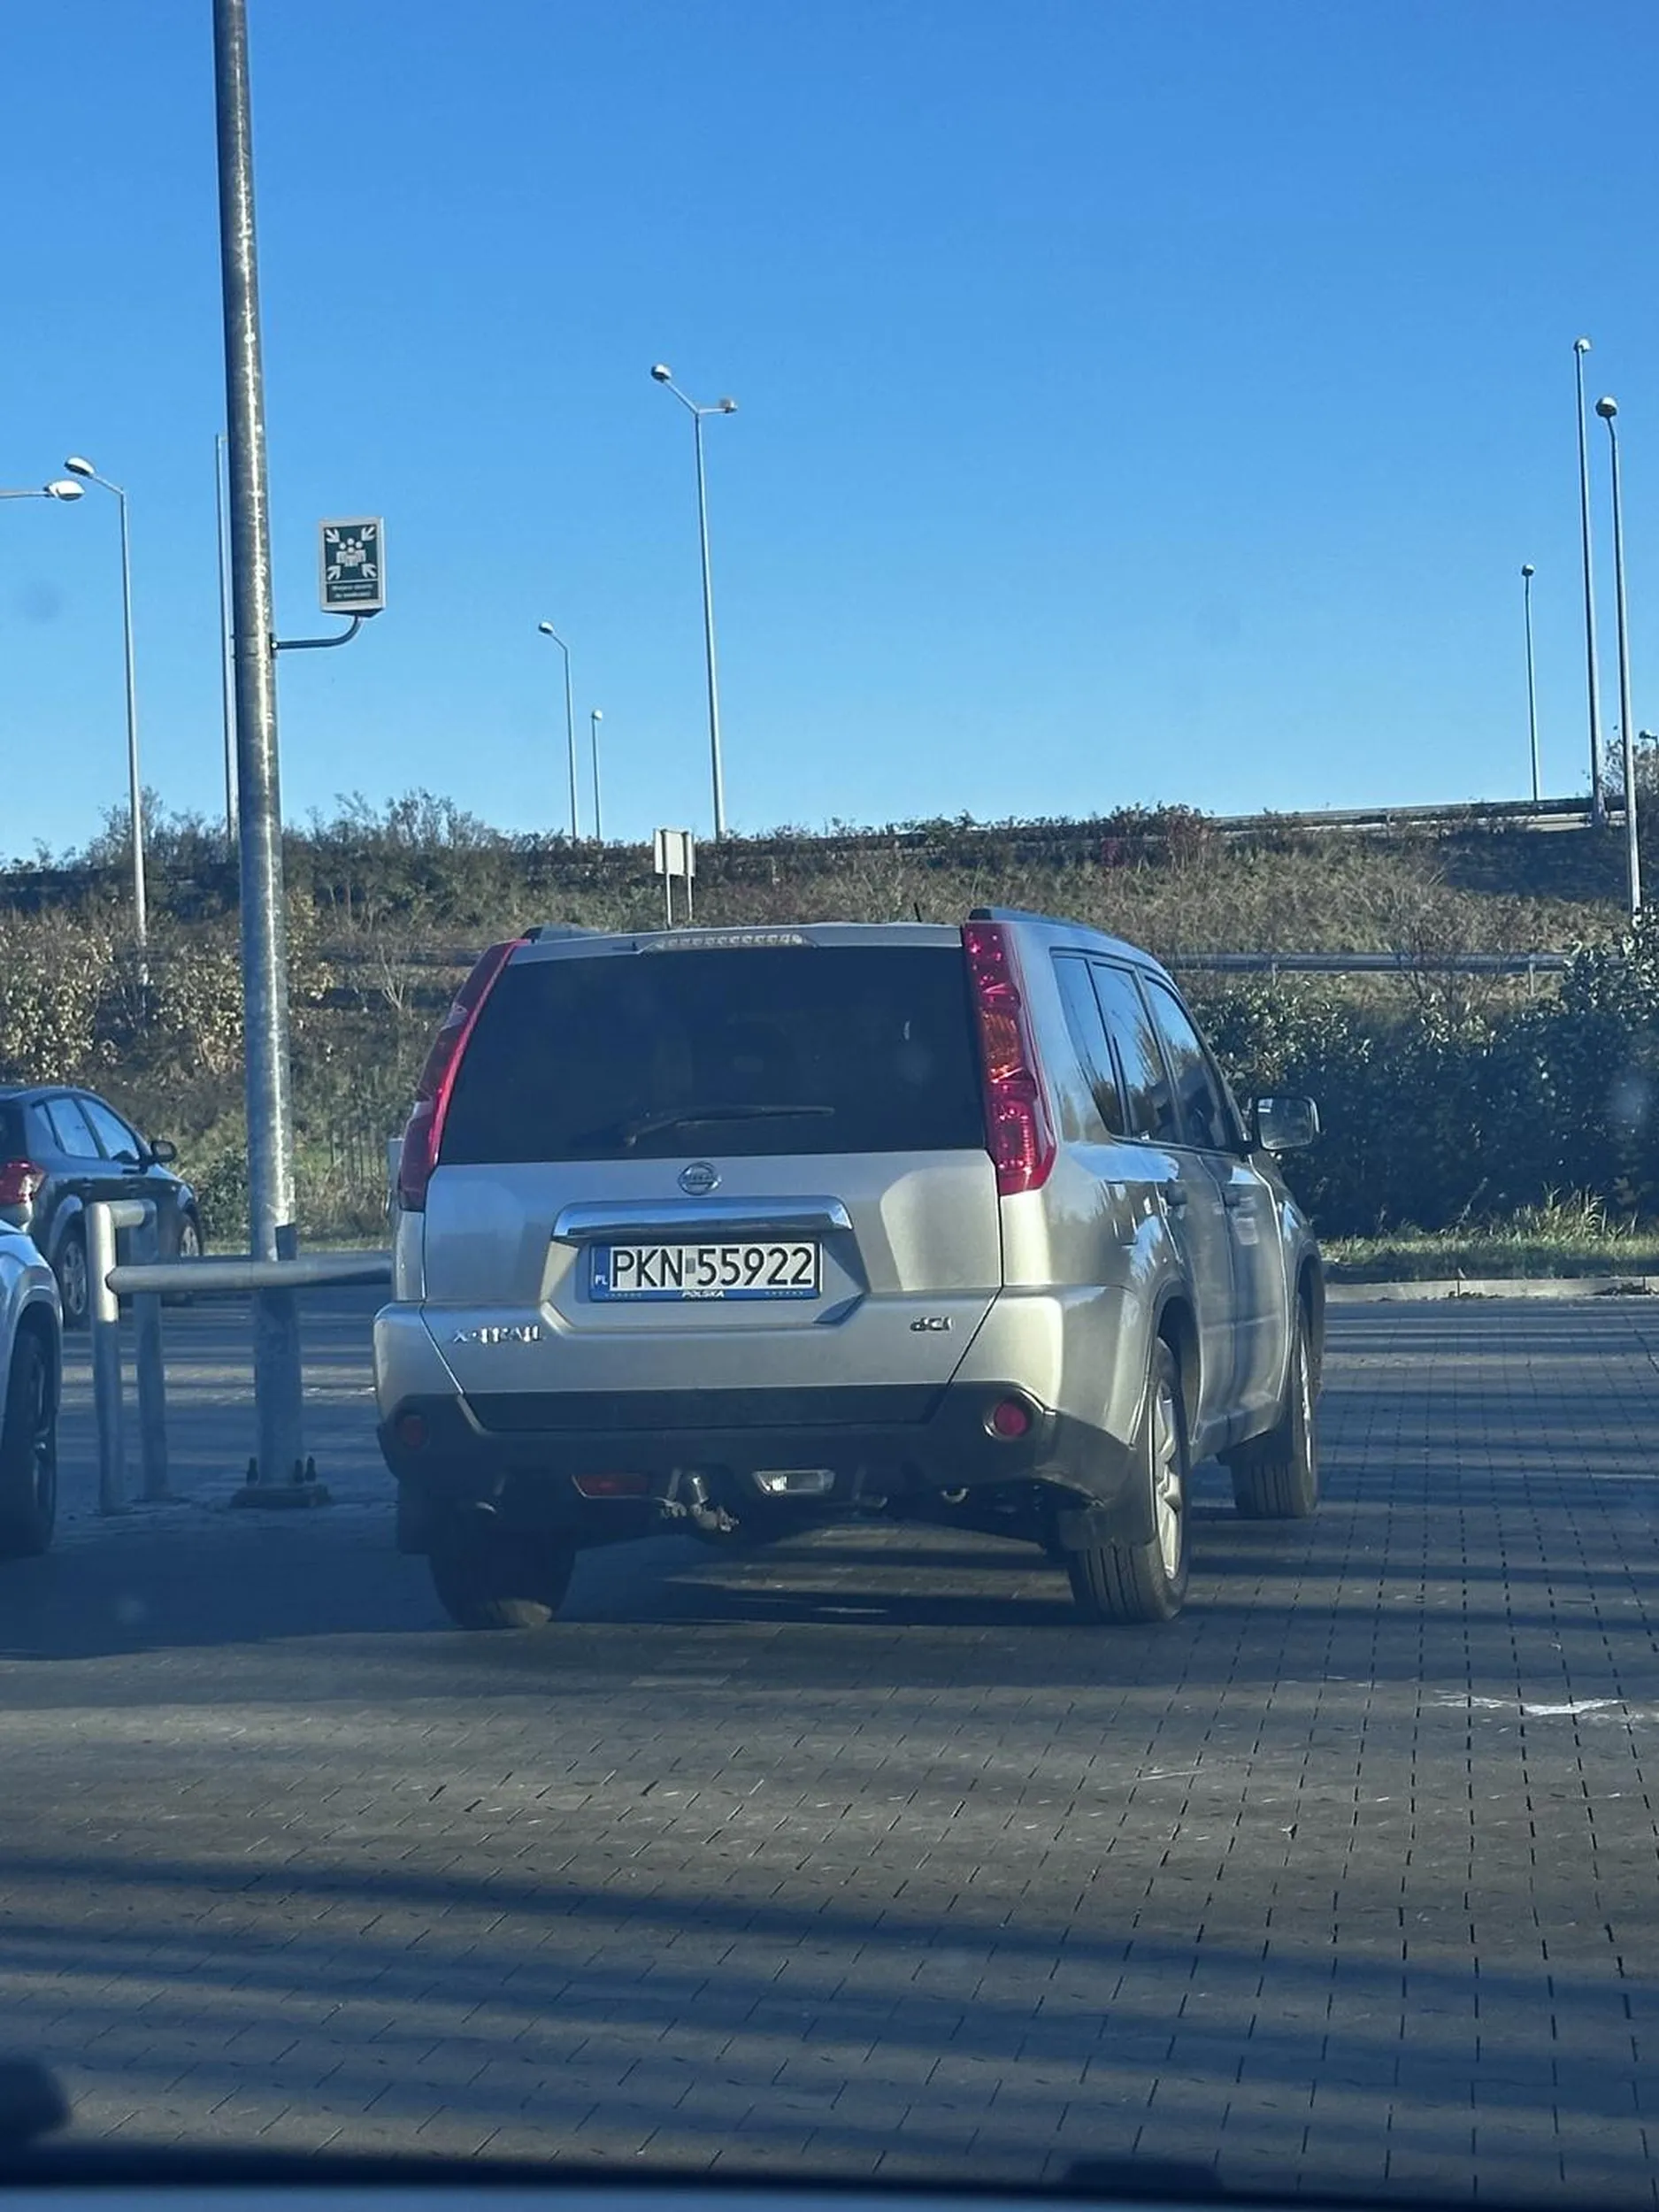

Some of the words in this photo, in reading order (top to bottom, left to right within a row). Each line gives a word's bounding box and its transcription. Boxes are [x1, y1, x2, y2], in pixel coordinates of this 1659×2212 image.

[595, 1274, 609, 1285] PL
[612, 1248, 683, 1287] PKN
[697, 1247, 812, 1286] 55922
